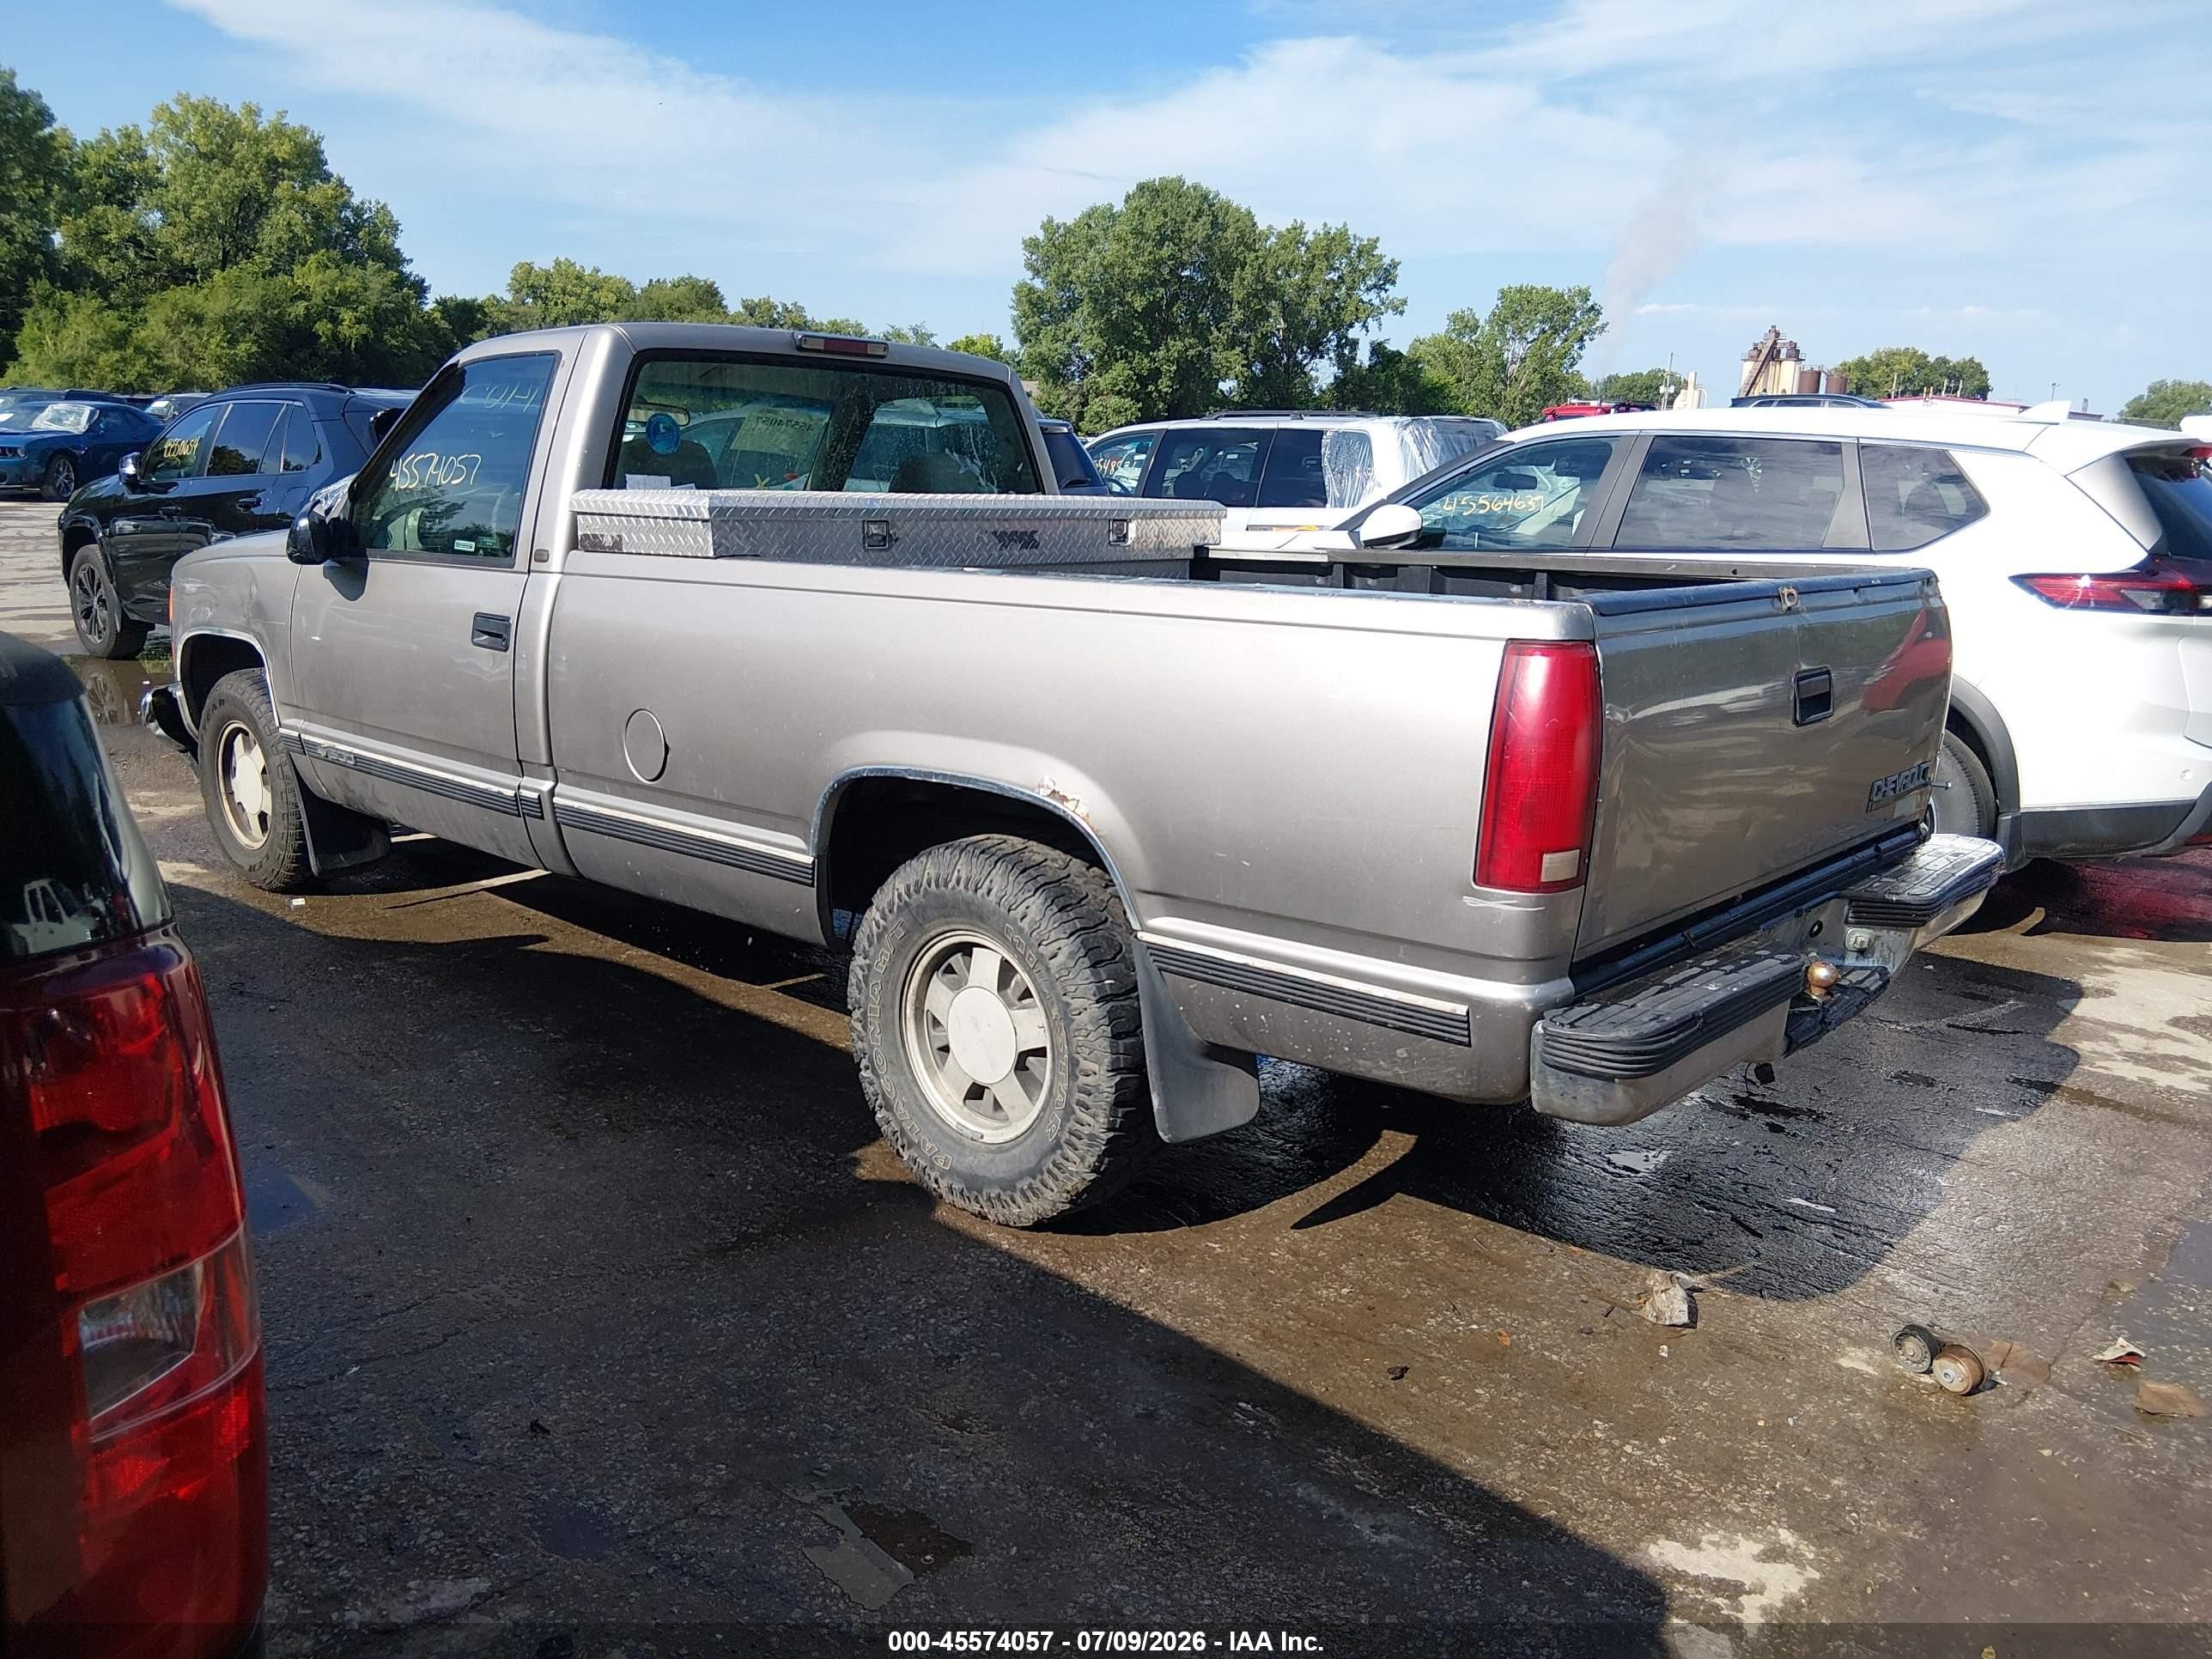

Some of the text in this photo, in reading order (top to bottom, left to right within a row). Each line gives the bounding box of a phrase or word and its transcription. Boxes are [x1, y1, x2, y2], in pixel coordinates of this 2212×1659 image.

[390, 453, 481, 491] 45574057
[1443, 494, 1544, 517] 45564637
[867, 921, 954, 1170] PATAGONIA M/T
